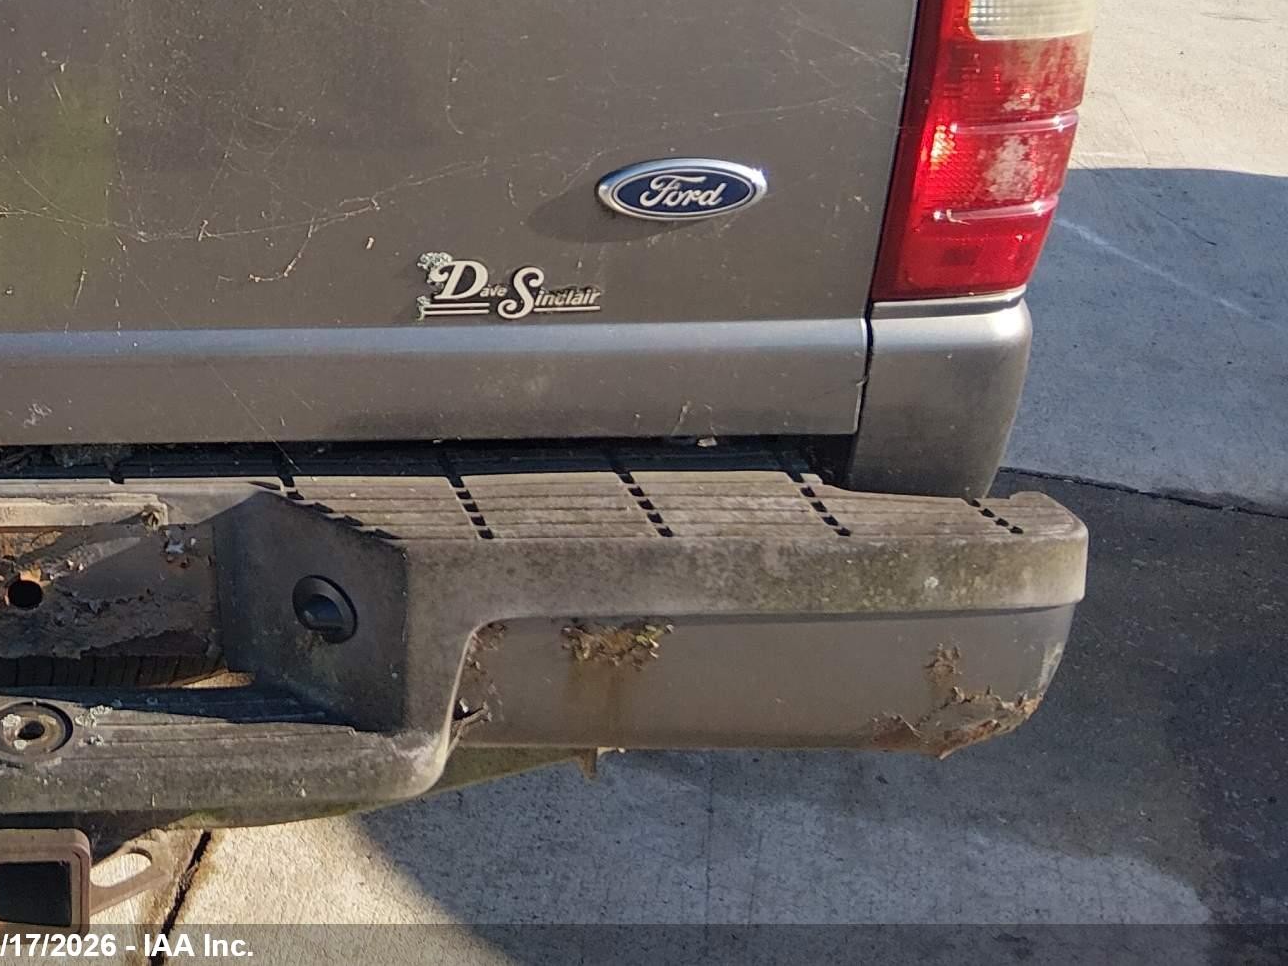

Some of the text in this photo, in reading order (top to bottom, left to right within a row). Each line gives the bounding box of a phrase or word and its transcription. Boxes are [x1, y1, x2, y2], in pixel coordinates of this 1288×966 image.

[639, 174, 727, 207] Ford
[429, 260, 601, 320] Dave Sinclair
